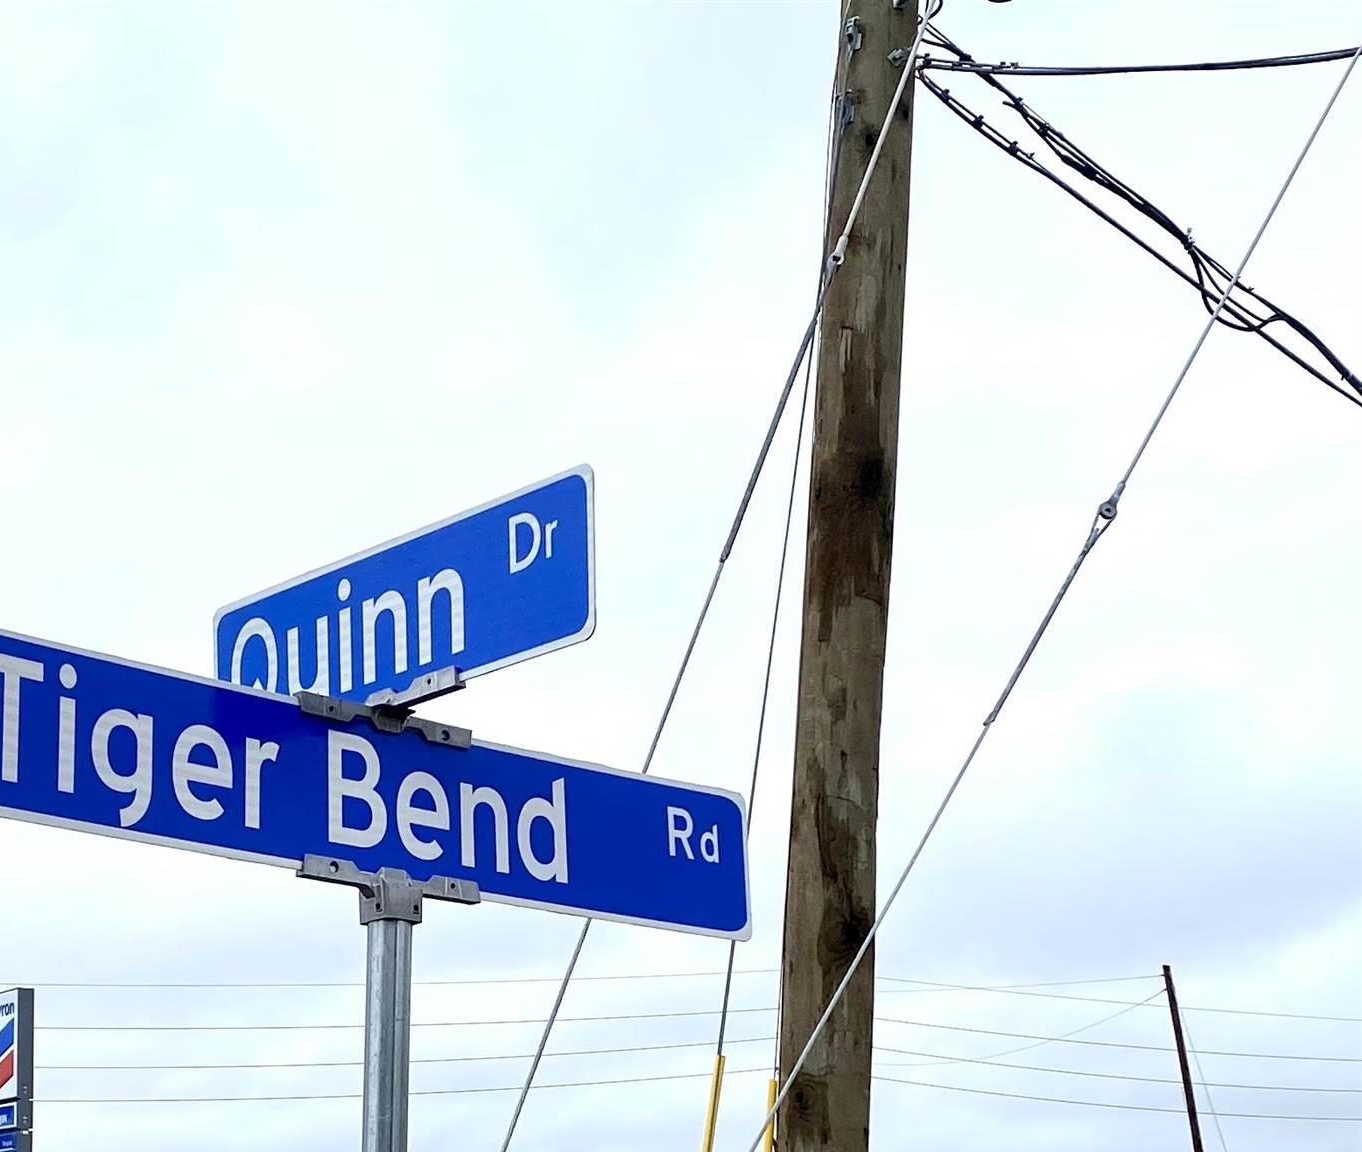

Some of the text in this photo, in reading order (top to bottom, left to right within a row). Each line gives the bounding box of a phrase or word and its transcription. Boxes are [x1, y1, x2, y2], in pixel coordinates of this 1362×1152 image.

[231, 512, 558, 697] Quinn Dr
[327, 730, 569, 884] Bend
[668, 806, 721, 863] Rd
